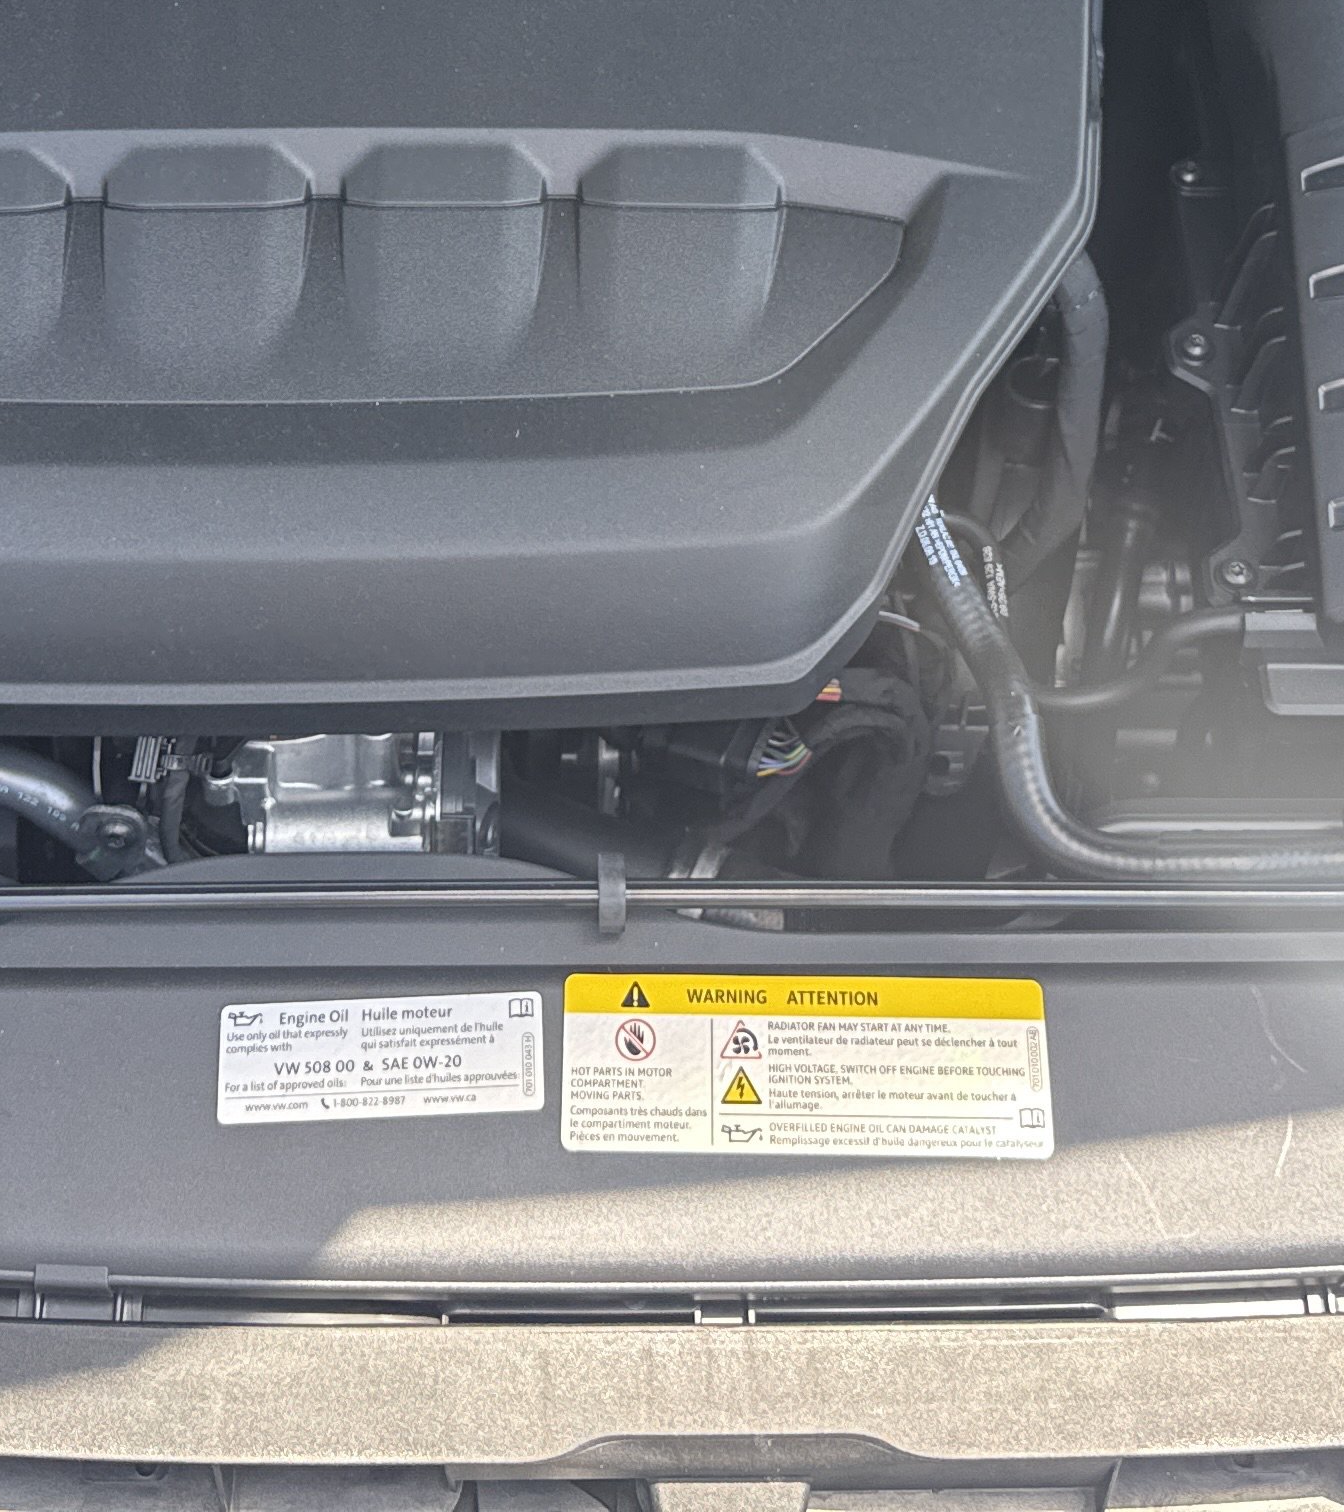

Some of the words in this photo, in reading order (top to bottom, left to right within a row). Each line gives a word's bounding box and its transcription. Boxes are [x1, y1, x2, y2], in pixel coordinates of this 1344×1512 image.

[686, 988, 767, 1004] WARNING
[786, 990, 878, 1006] ATTENTION
[279, 1011, 326, 1028] Engine
[329, 1008, 348, 1023] Oil
[362, 1006, 398, 1022] Huile
[402, 1006, 453, 1020] moteur
[361, 1026, 397, 1038] Utilisez
[399, 1024, 458, 1038] uniquement
[460, 1022, 473, 1033] de
[474, 1021, 504, 1032] l'huile
[767, 1021, 815, 1031] RADIATOR
[817, 1022, 836, 1032] FAN
[838, 1022, 858, 1032] MAY
[860, 1022, 889, 1032] START
[890, 1023, 902, 1032] AT
[904, 1023, 923, 1033] ANY
[924, 1024, 951, 1033] TIME.
[226, 1032, 245, 1042] Use
[246, 1030, 268, 1044] only
[268, 1029, 281, 1040] oil
[282, 1029, 302, 1039] that
[304, 1026, 348, 1040] expressly
[768, 1034, 780, 1044] Le
[781, 1034, 834, 1045] ventilateur
[836, 1035, 848, 1046] de
[850, 1036, 895, 1046] radiateur
[896, 1038, 919, 1048] peut
[921, 1038, 932, 1047] se
[934, 1036, 986, 1048] déclencher
[988, 1037, 995, 1048] à
[997, 1039, 1018, 1048] tout
[226, 1043, 268, 1056] complies
[270, 1041, 292, 1052] with
[360, 1039, 377, 1052] qui
[378, 1037, 417, 1049] satisfait
[419, 1034, 487, 1049] expressément
[488, 1034, 495, 1044] à
[768, 1048, 812, 1056] moment.
[274, 1062, 300, 1076] VW
[304, 1060, 331, 1074] 508
[335, 1059, 355, 1073] 00
[362, 1060, 374, 1072] &
[382, 1056, 408, 1071] SAE
[412, 1054, 462, 1069] 0W-20
[571, 1066, 591, 1076] HOT
[593, 1066, 623, 1076] PARTS
[624, 1067, 635, 1077] IN
[638, 1067, 672, 1077] MOTOR
[768, 1064, 792, 1073] HIGH
[840, 1064, 877, 1074] SWITCH
[878, 1064, 897, 1075] OFF
[899, 1065, 935, 1076] ENGINE
[937, 1066, 974, 1076] BEFORE
[976, 1066, 1026, 1077] TOUCHING
[224, 1082, 240, 1093] For
[242, 1084, 248, 1092] a
[250, 1080, 265, 1092] list
[266, 1080, 278, 1091] of
[279, 1078, 325, 1093] approved
[326, 1077, 346, 1088] oils:
[360, 1076, 383, 1086] Pour
[384, 1077, 403, 1086] une
[404, 1074, 424, 1085] liste
[425, 1072, 462, 1084] d'huiles
[464, 1070, 518, 1084] approuvées:
[768, 1074, 811, 1084] IGNITION
[813, 1075, 853, 1085] SYSTEM.
[570, 1090, 610, 1100] MOVING
[612, 1090, 644, 1101] PARTS.
[768, 1088, 798, 1098] Haute
[800, 1090, 840, 1101] tension,
[842, 1089, 875, 1100] arrêter
[877, 1090, 886, 1100] le
[888, 1091, 924, 1100] moteur
[926, 1092, 954, 1101] avant
[956, 1090, 968, 1101] de
[970, 1091, 1008, 1102] toucher
[1010, 1092, 1017, 1102] à
[570, 1104, 628, 1118] Composants
[630, 1106, 648, 1116] très
[650, 1106, 683, 1117] chauds
[684, 1106, 708, 1117] dans
[570, 1118, 579, 1128] le
[580, 1119, 651, 1131] compartiment
[654, 1120, 691, 1130] moteur.
[769, 1122, 828, 1132] OVERFILLED
[830, 1123, 866, 1133] ENGINE
[868, 1124, 884, 1134] OIL
[886, 1124, 906, 1134] CAN
[908, 1124, 949, 1134] DAMAGE
[952, 1124, 996, 1135] CATALYST
[570, 1130, 600, 1142] Pièces
[602, 1133, 615, 1142] en
[618, 1133, 679, 1142] mouvement.
